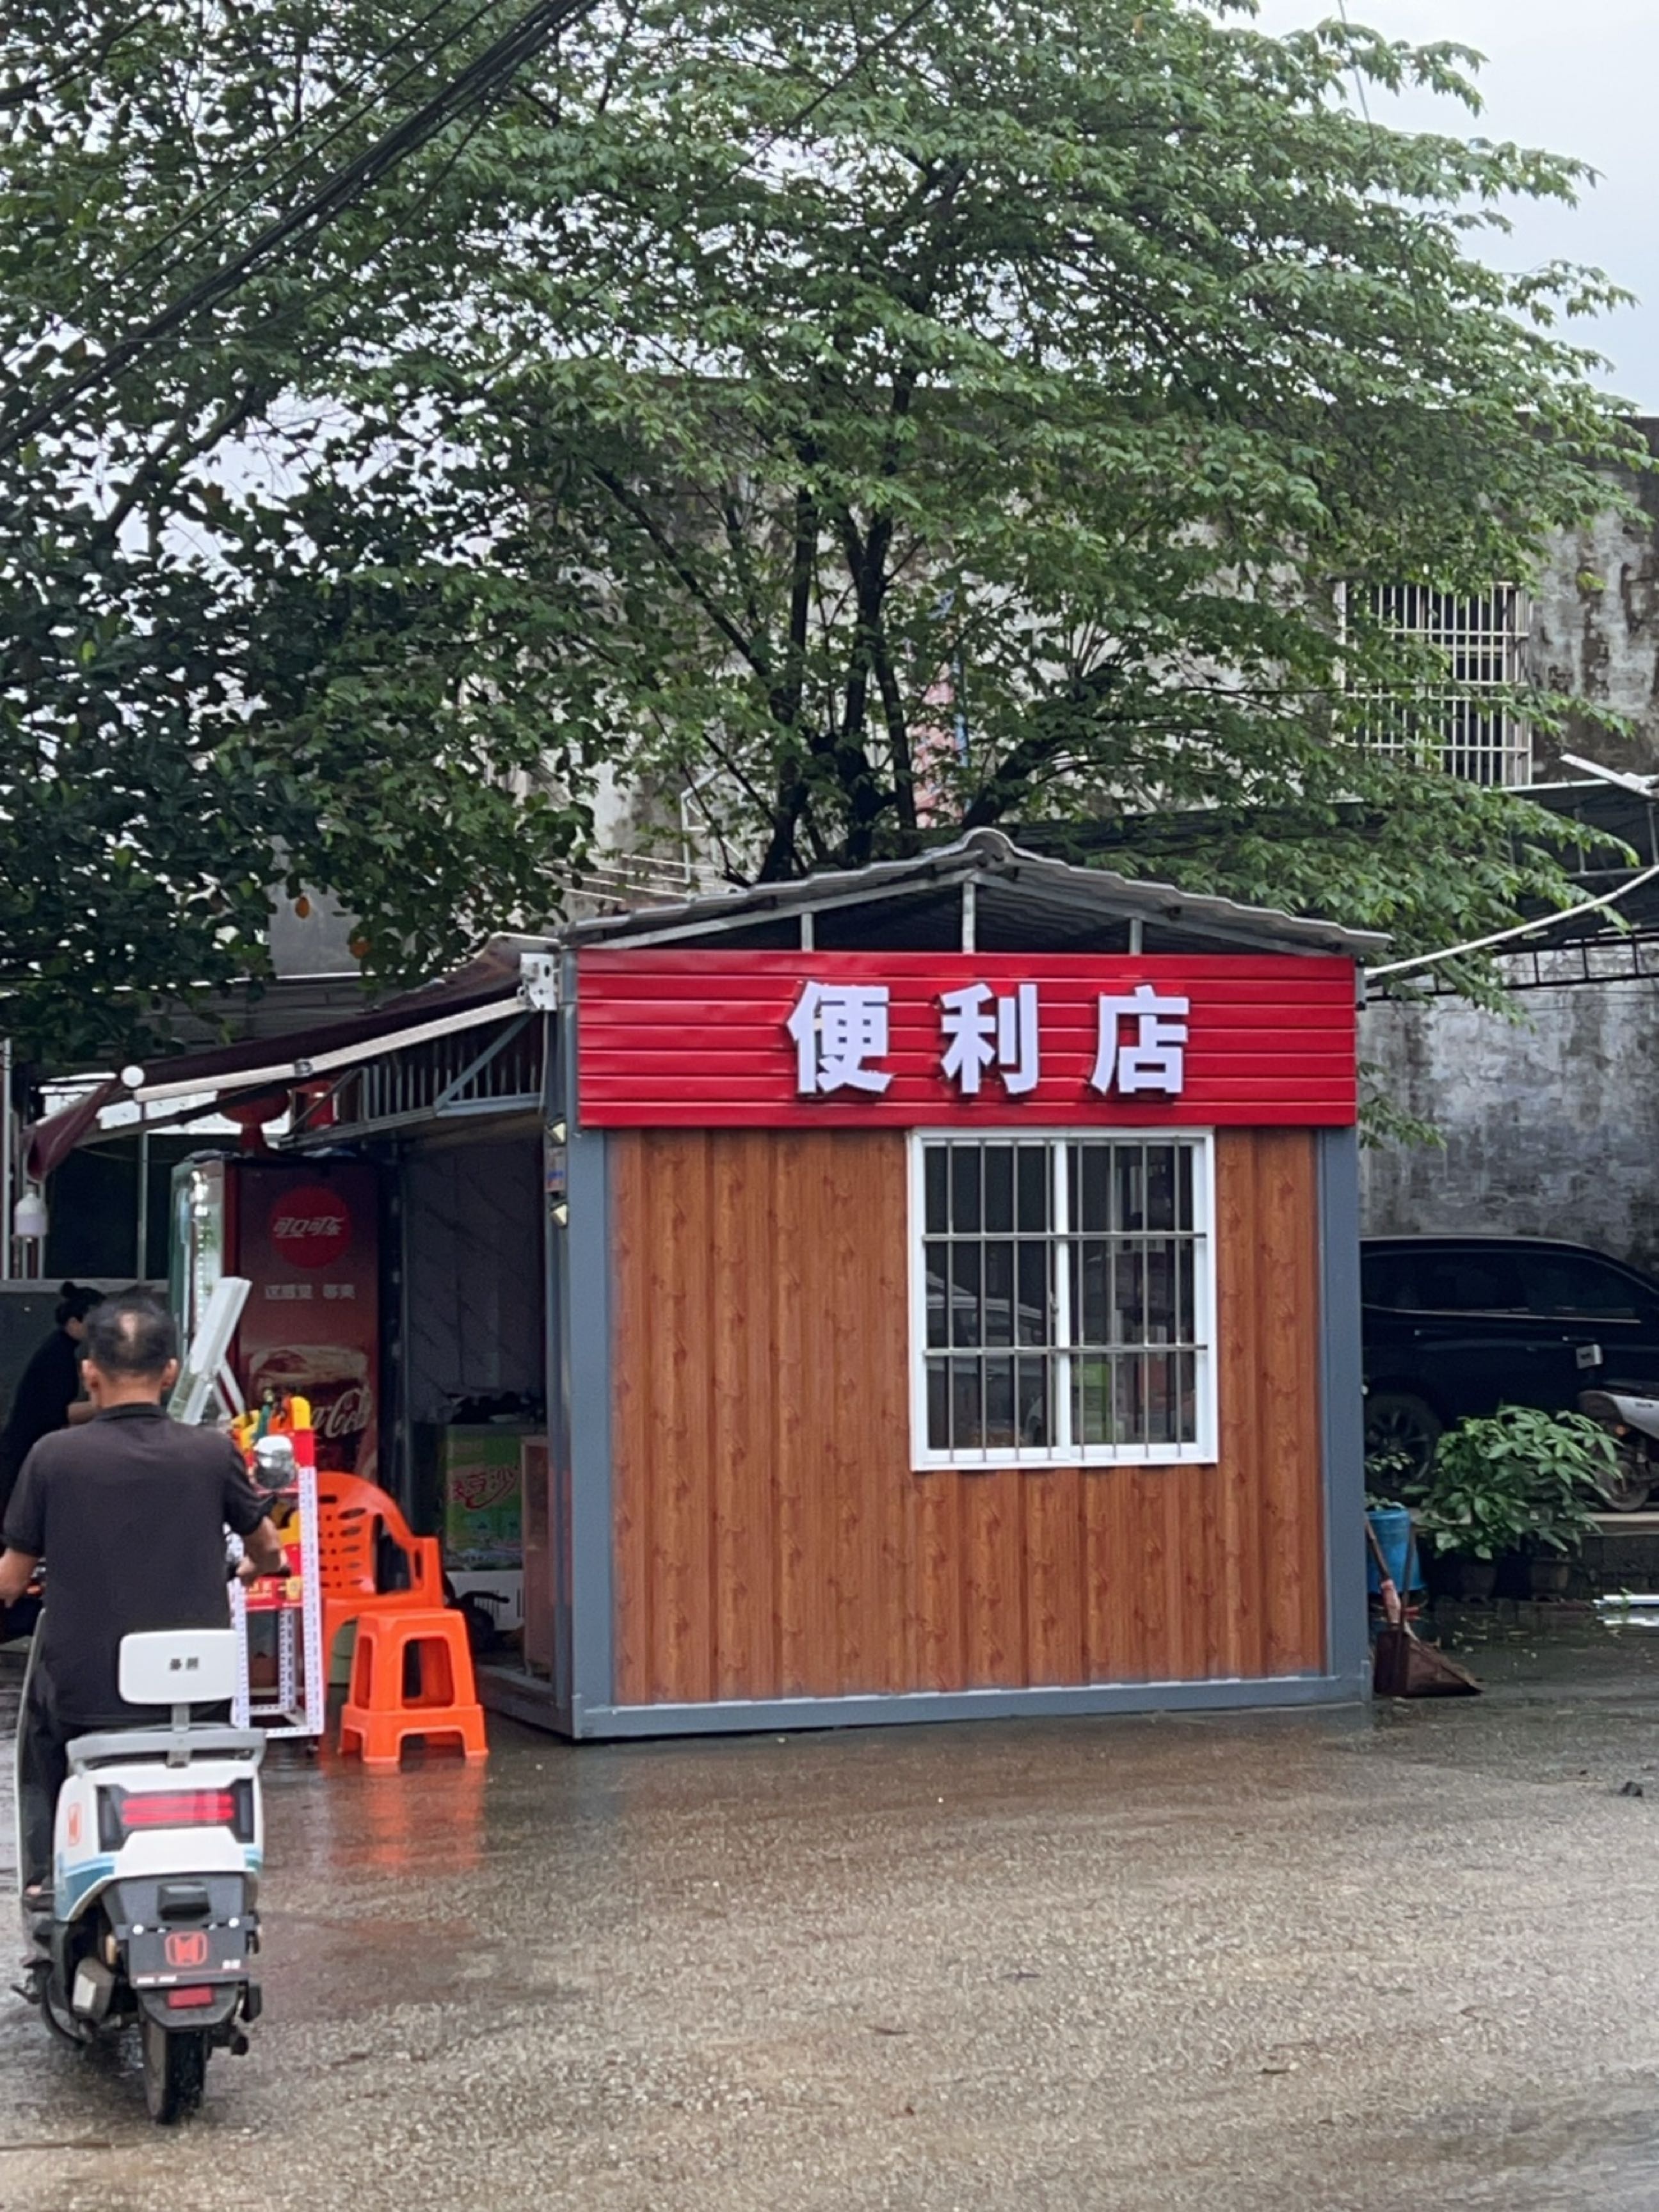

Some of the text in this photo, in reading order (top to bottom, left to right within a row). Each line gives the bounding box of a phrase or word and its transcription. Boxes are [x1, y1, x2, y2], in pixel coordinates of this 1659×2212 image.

[787, 980, 1189, 1094] 便利店
[273, 1216, 346, 1238] 可口可乐
